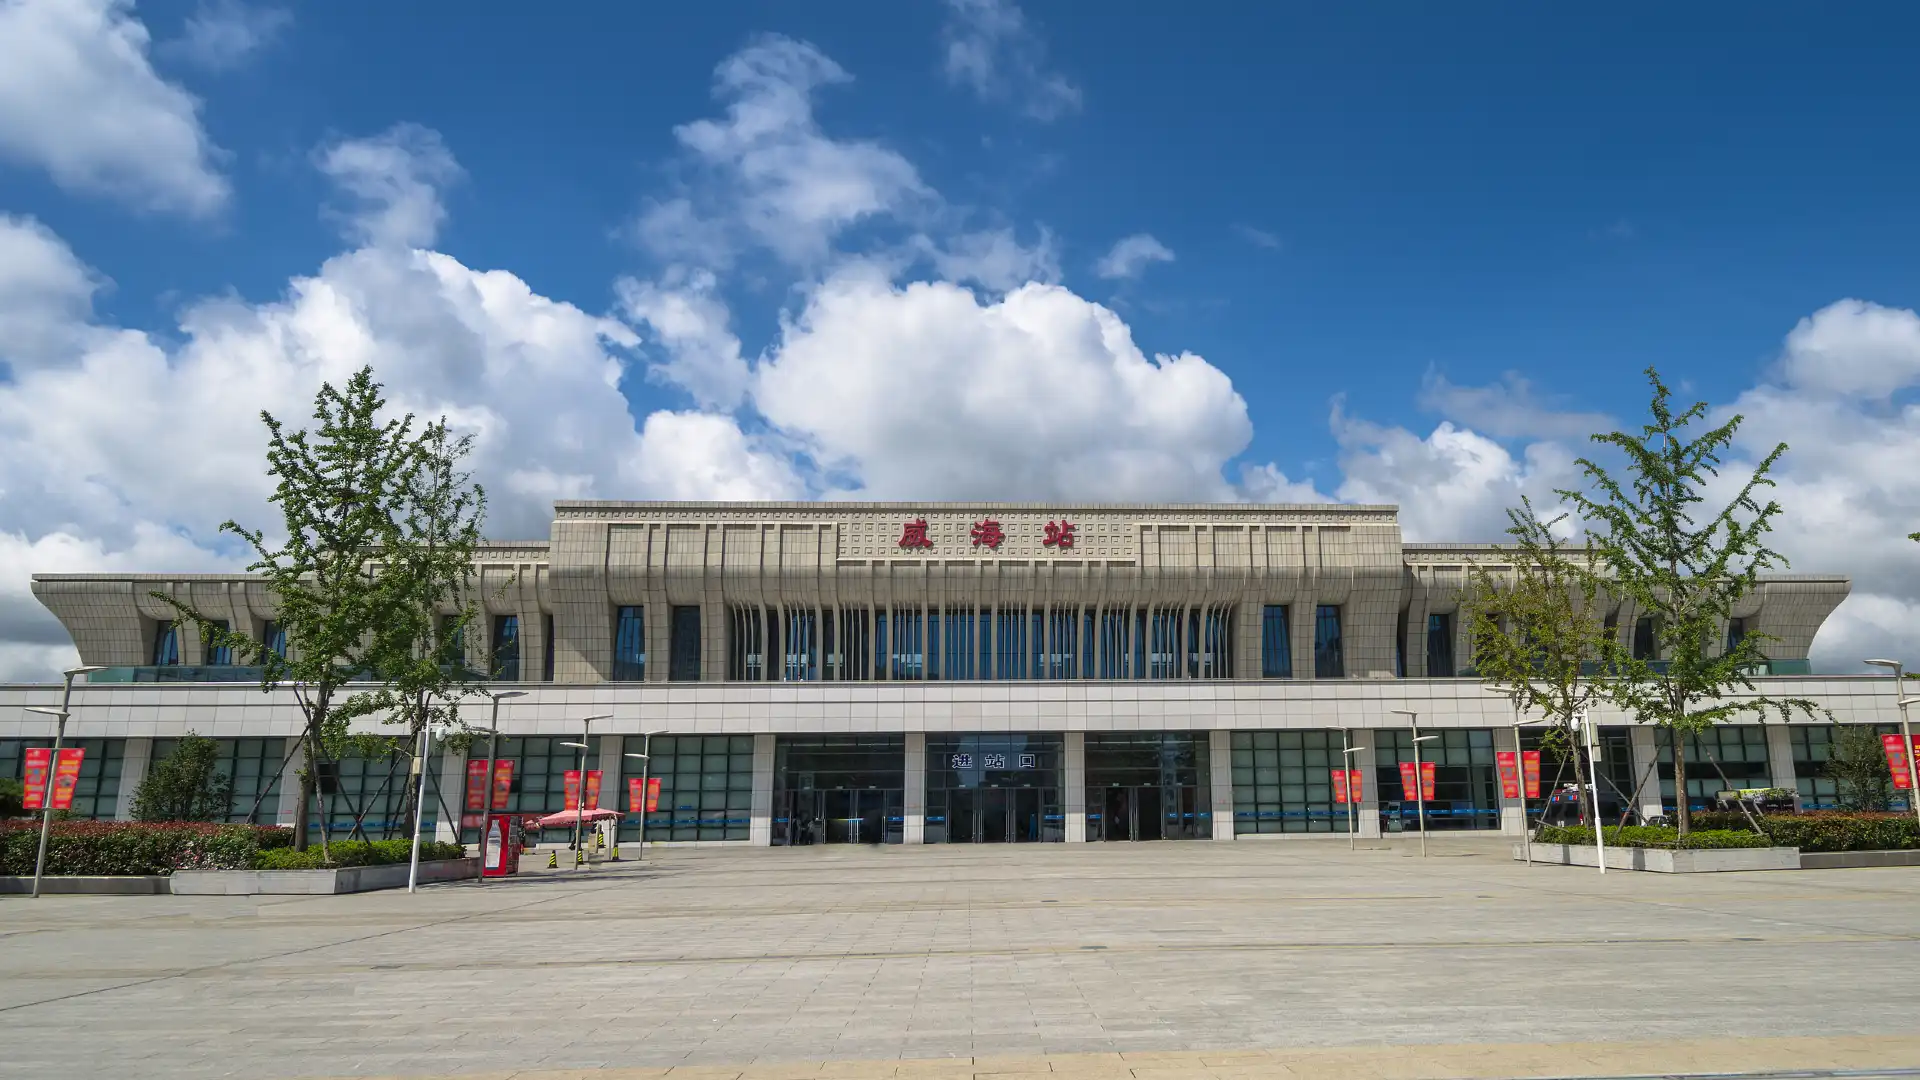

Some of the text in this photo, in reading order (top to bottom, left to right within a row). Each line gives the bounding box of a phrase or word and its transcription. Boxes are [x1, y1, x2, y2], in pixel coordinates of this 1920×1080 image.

[898, 519, 1076, 548] 威海站
[952, 753, 1035, 769] 进站口
